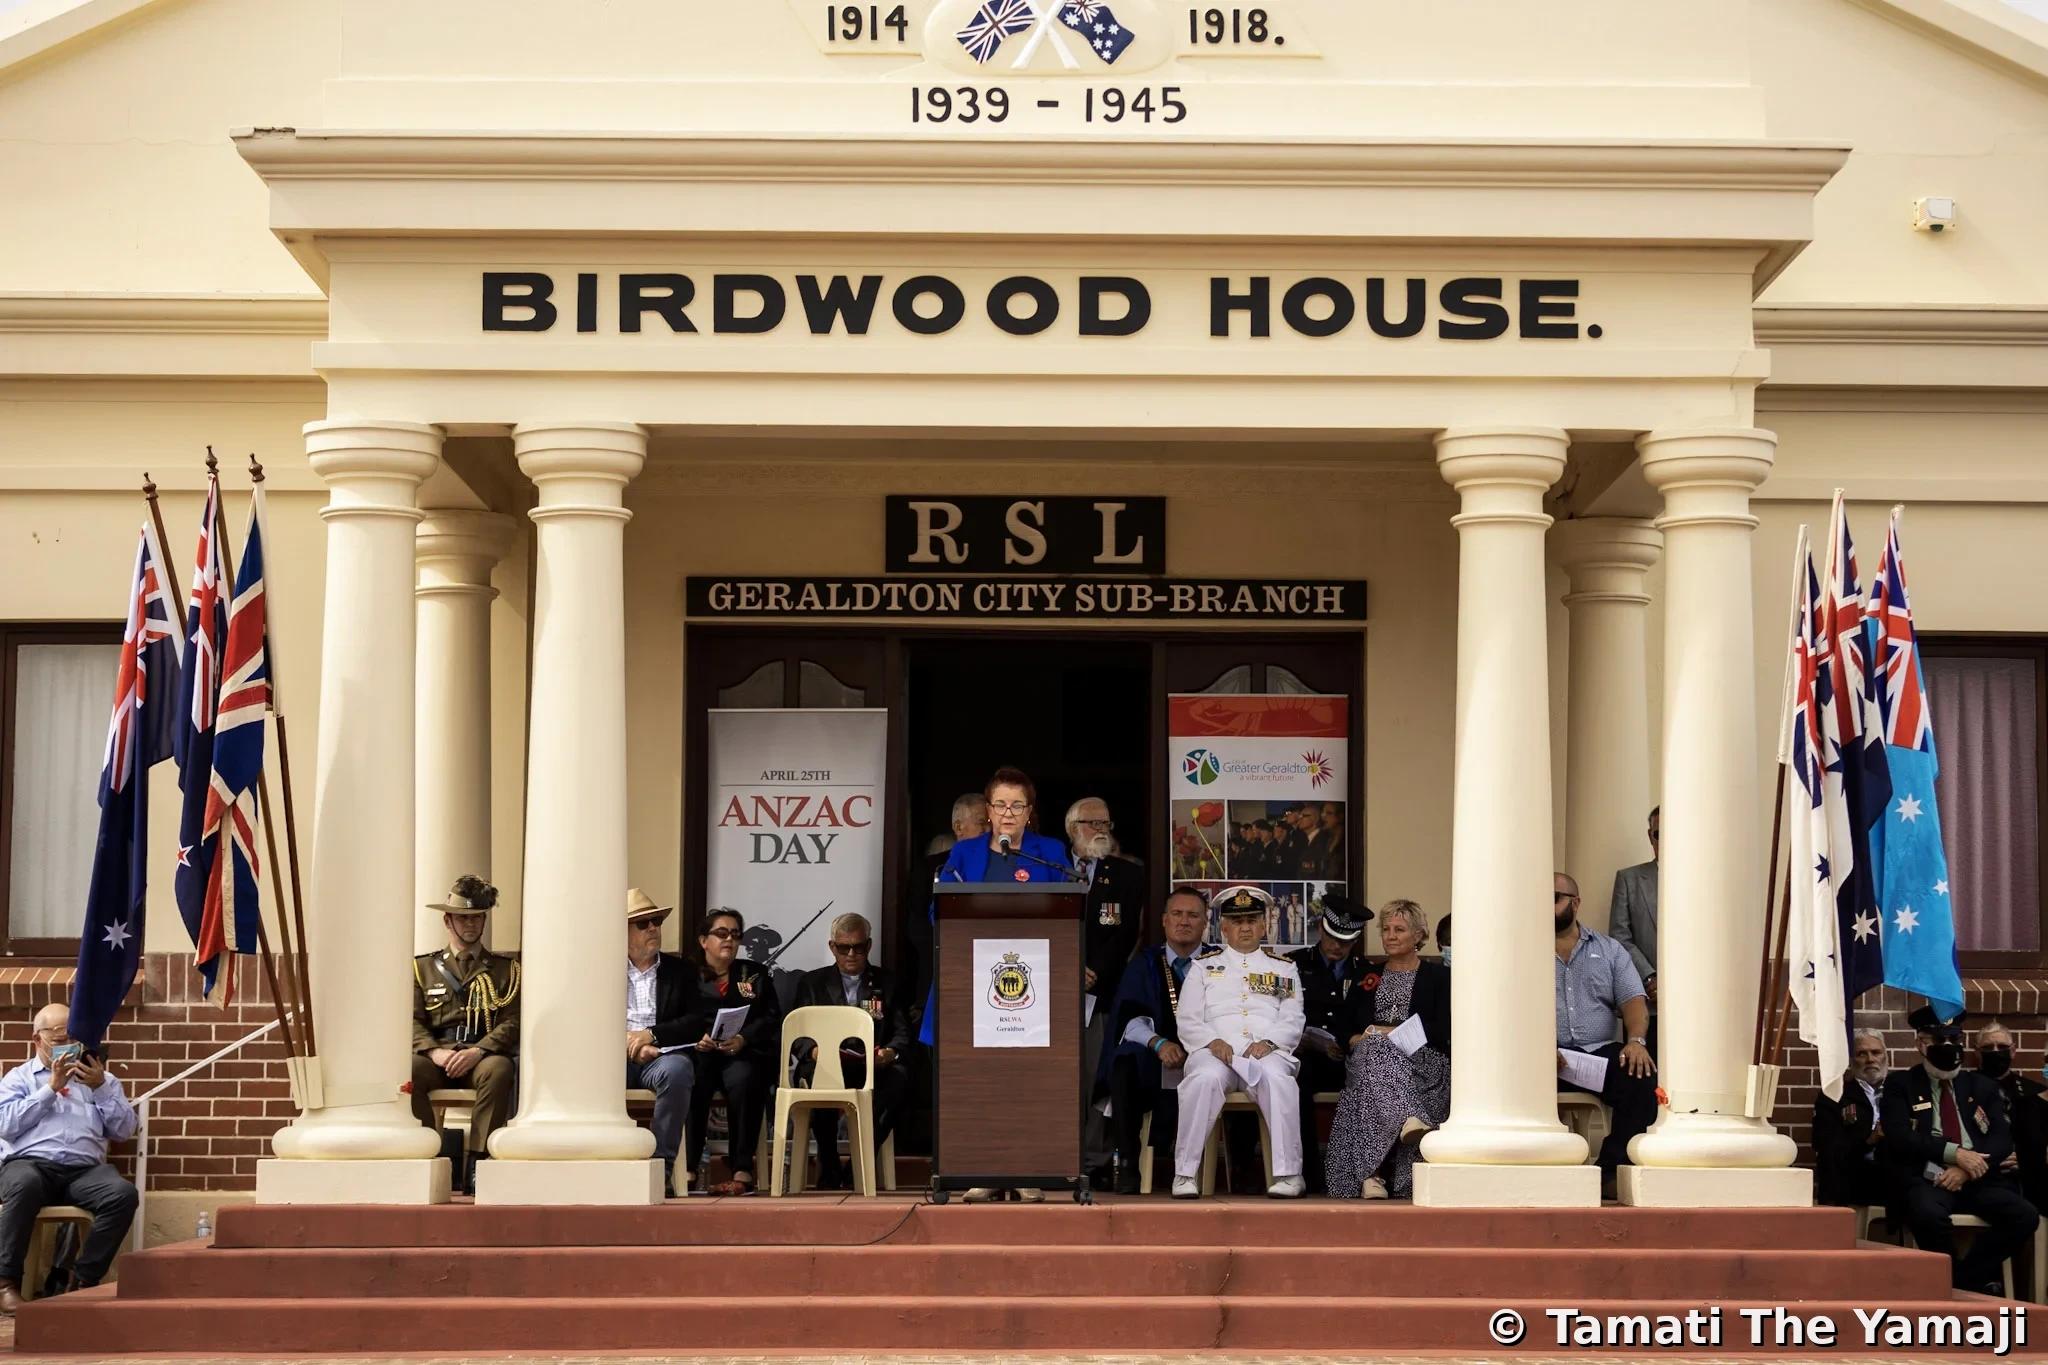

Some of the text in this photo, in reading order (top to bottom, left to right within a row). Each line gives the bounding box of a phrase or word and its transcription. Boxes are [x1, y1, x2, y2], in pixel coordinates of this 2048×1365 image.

[827, 4, 909, 42] 1914
[1189, 8, 1285, 46] 1918.
[912, 86, 1009, 124] 1939
[1085, 86, 1187, 124] 1945
[481, 271, 1603, 341] BIRDWOOD HOUSE.
[707, 582, 1345, 615] GERALDTON CITY SUB-BRANCH
[760, 770, 831, 781] APRIL 25TH
[1222, 761, 1261, 773] Greater
[1245, 774, 1270, 782] vibrant
[1272, 774, 1295, 782] future
[718, 794, 872, 828] ANZAC
[748, 832, 839, 864] DAY
